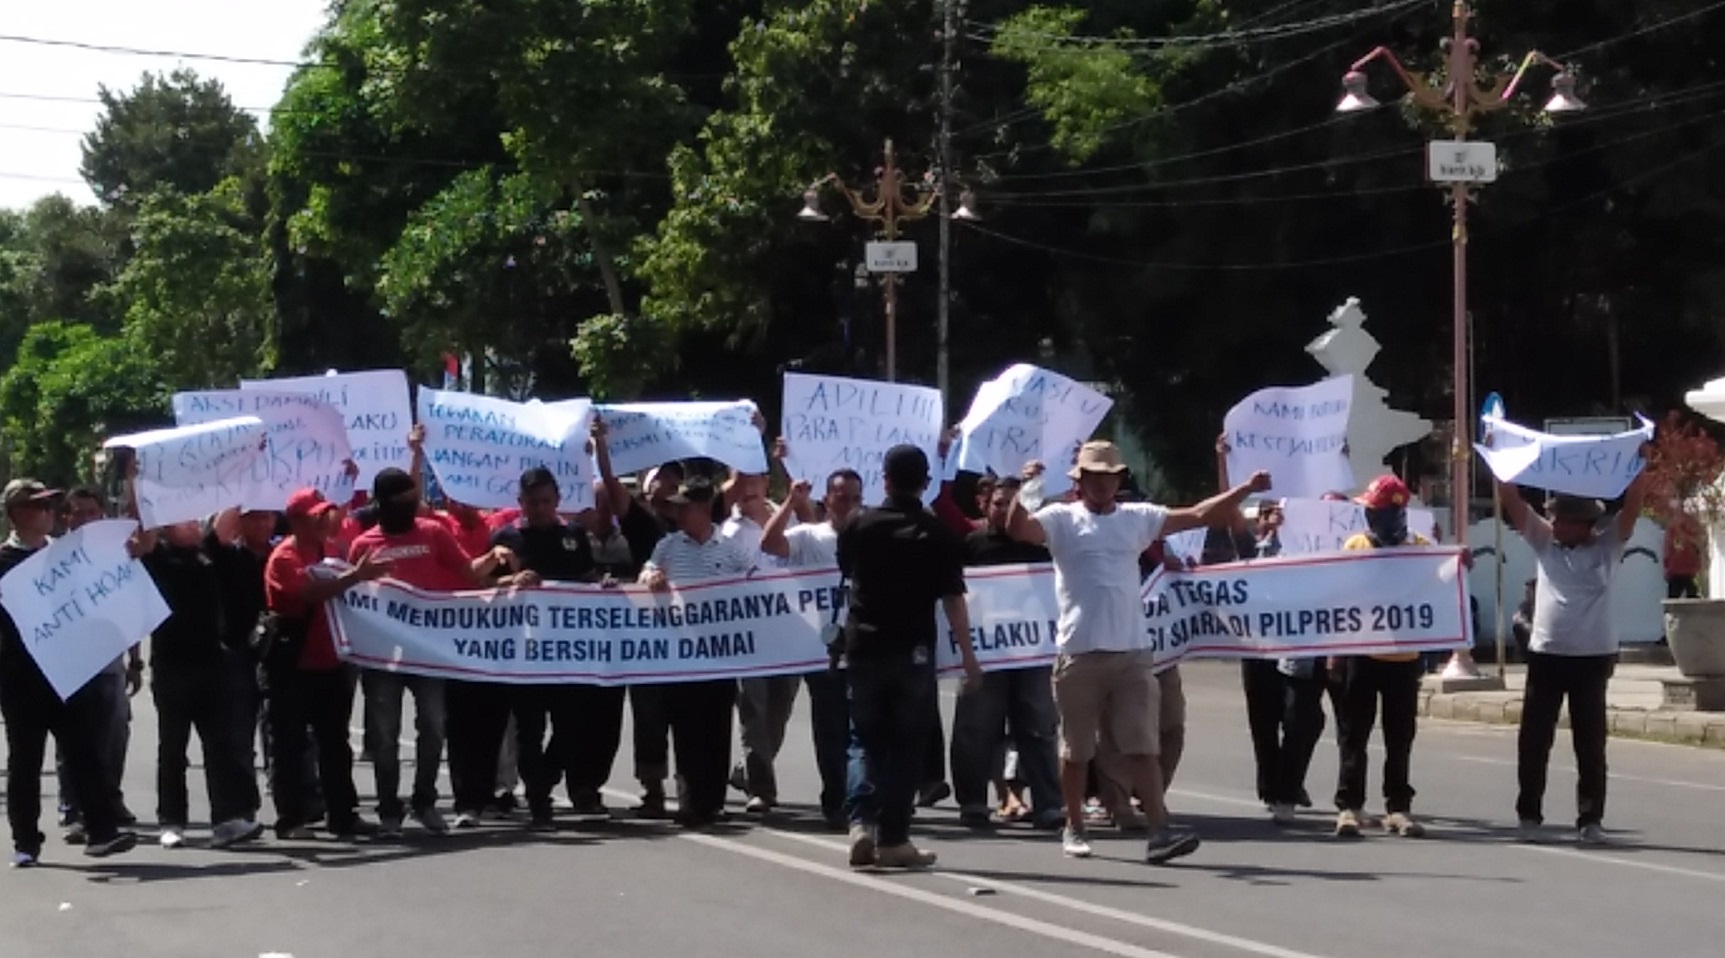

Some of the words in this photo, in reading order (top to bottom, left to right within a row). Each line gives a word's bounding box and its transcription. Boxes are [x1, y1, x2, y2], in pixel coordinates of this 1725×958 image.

[190, 395, 244, 413] AKSI
[786, 413, 838, 442] PARA
[33, 547, 91, 597] KAMI
[386, 599, 540, 629] MENDUKUNG
[547, 591, 790, 630] TERSELENGGARANYA
[1170, 579, 1249, 608] TEGAS
[33, 588, 84, 646] ANTI
[1260, 606, 1362, 638] PILPRES
[1371, 602, 1434, 631] 2019
[453, 638, 516, 662] YANG
[525, 638, 613, 662] BERSIH
[620, 638, 670, 662] DAN
[678, 630, 756, 659] DAMAI
